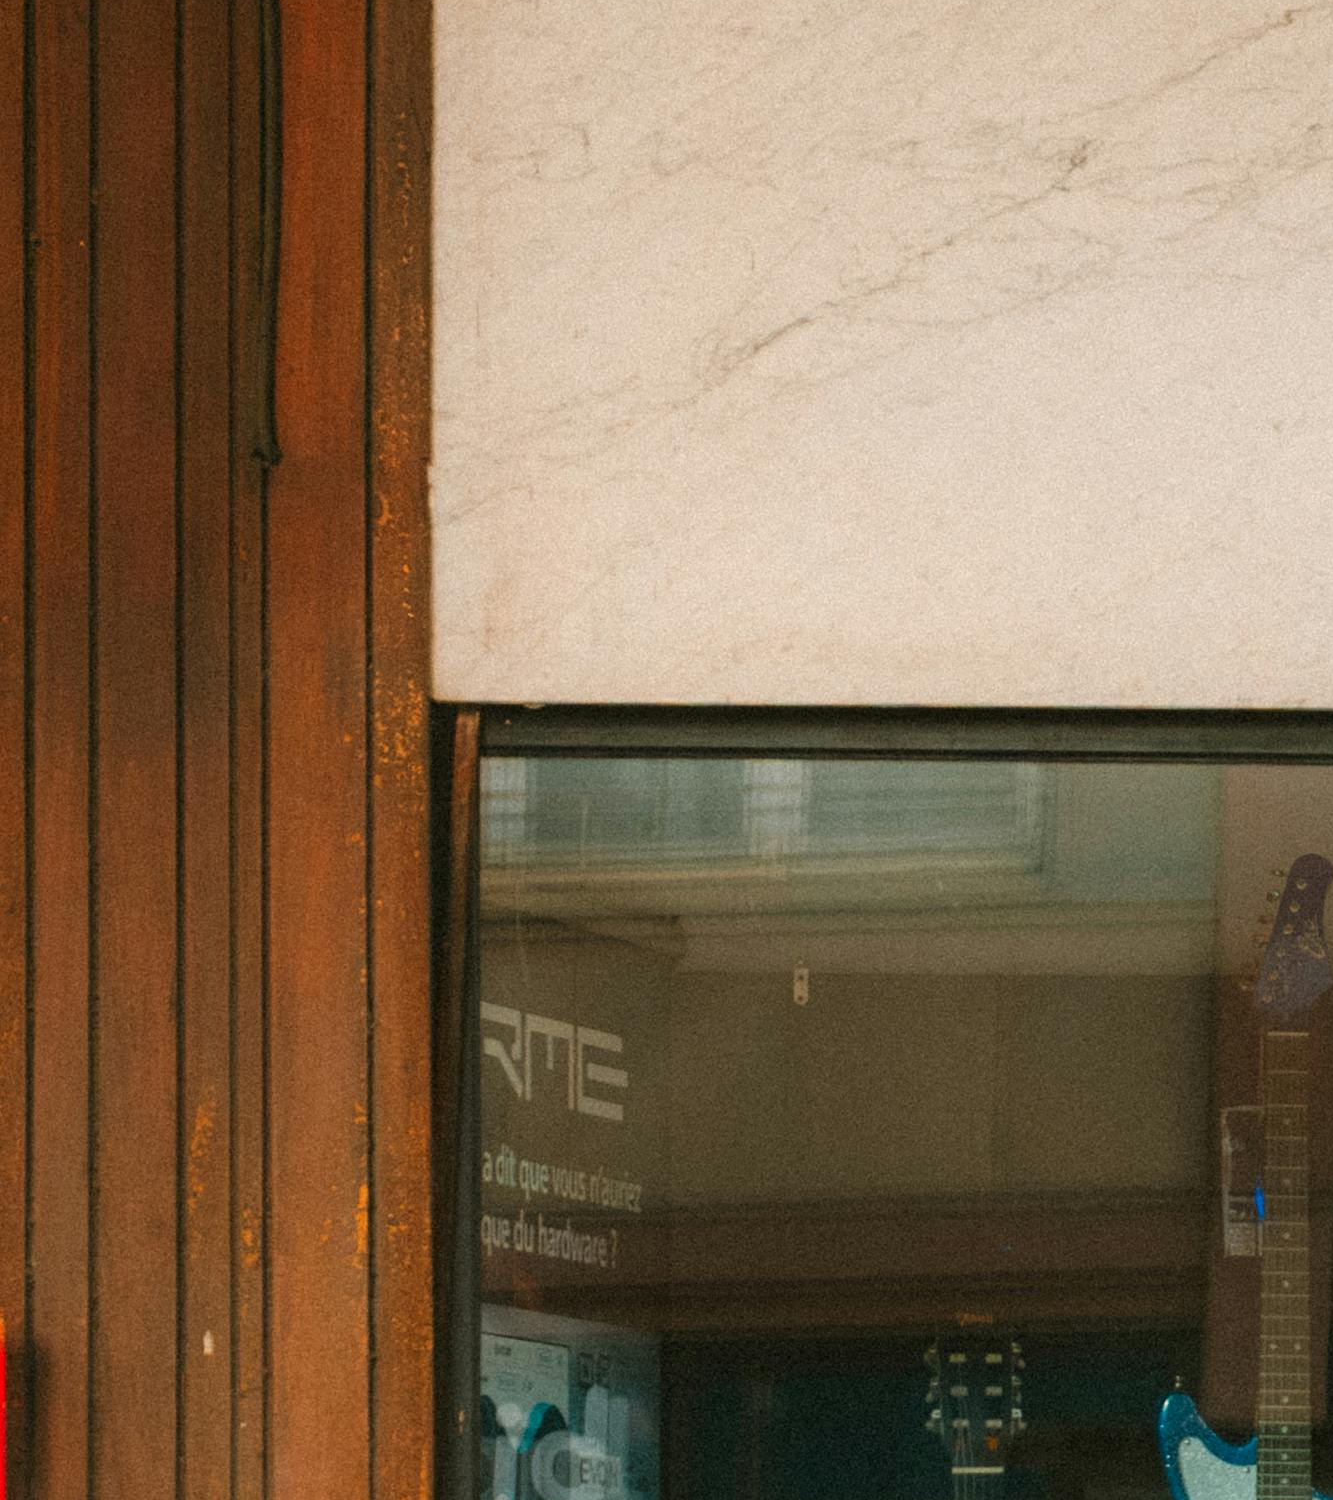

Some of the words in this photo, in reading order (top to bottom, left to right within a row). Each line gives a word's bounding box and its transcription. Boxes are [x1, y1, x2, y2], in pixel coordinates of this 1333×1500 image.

[495, 1143, 517, 1188] dit
[519, 1158, 549, 1201] que
[551, 1166, 586, 1202] vous
[481, 1214, 510, 1256] que
[513, 1209, 535, 1253] du
